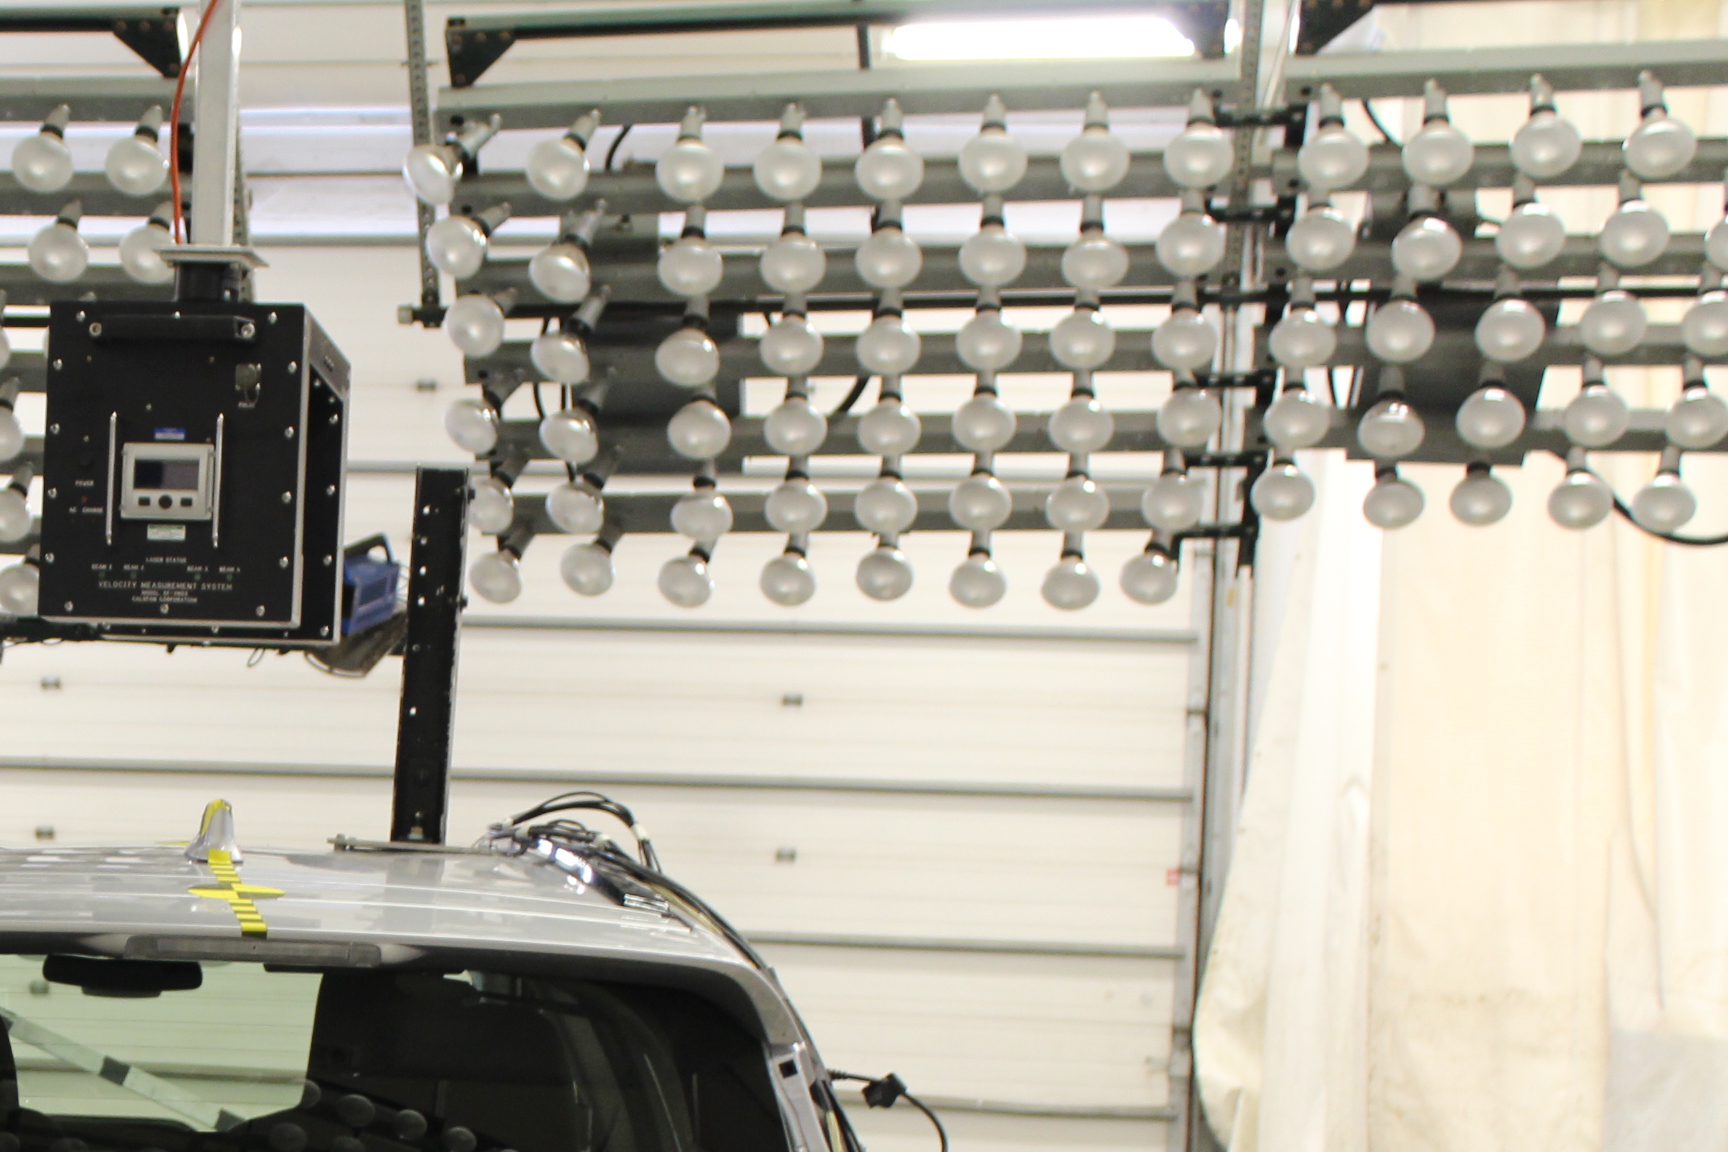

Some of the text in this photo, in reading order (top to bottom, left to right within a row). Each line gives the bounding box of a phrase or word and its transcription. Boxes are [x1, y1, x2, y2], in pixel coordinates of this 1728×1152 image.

[98, 580, 233, 591] VELOCITY MEASUREMENT SYSTEM
